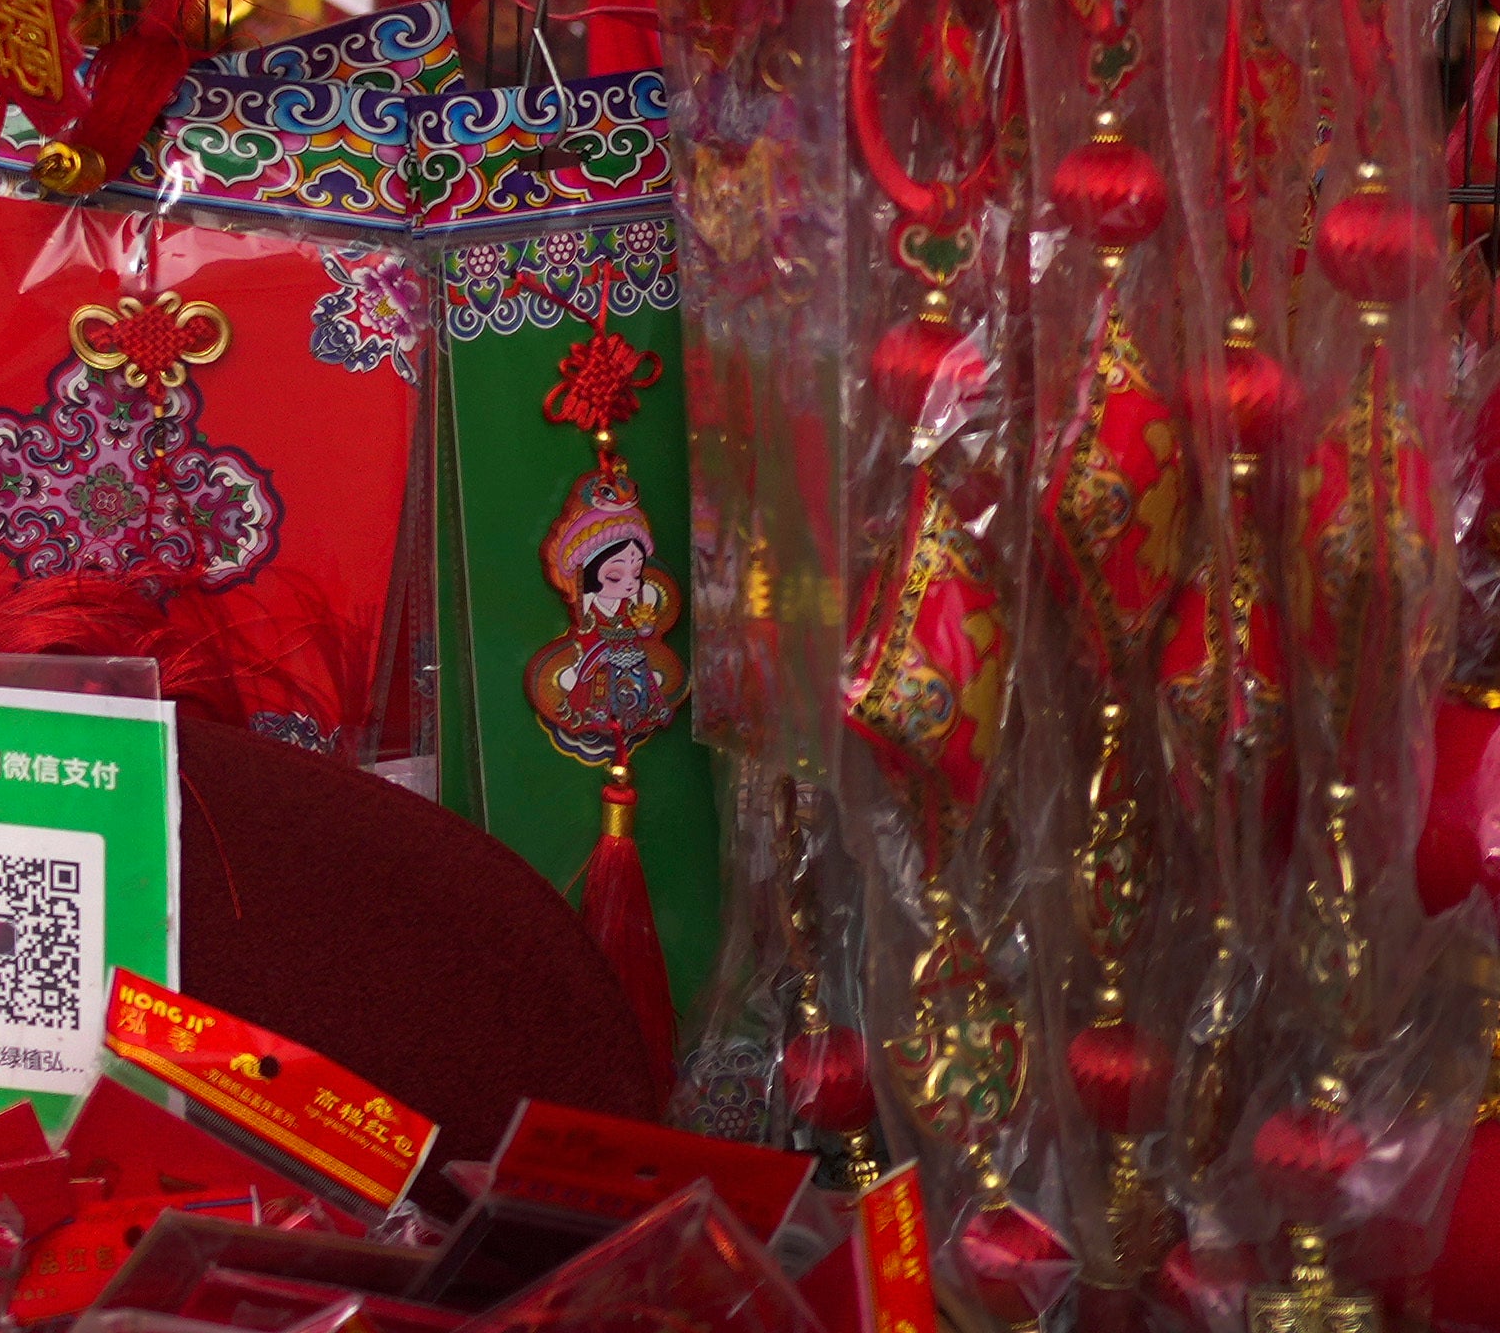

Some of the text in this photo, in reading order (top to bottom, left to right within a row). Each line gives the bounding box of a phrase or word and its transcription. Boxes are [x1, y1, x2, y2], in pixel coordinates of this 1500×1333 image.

[117, 984, 184, 1025] HONG
[313, 1086, 416, 1159] 高档红包
